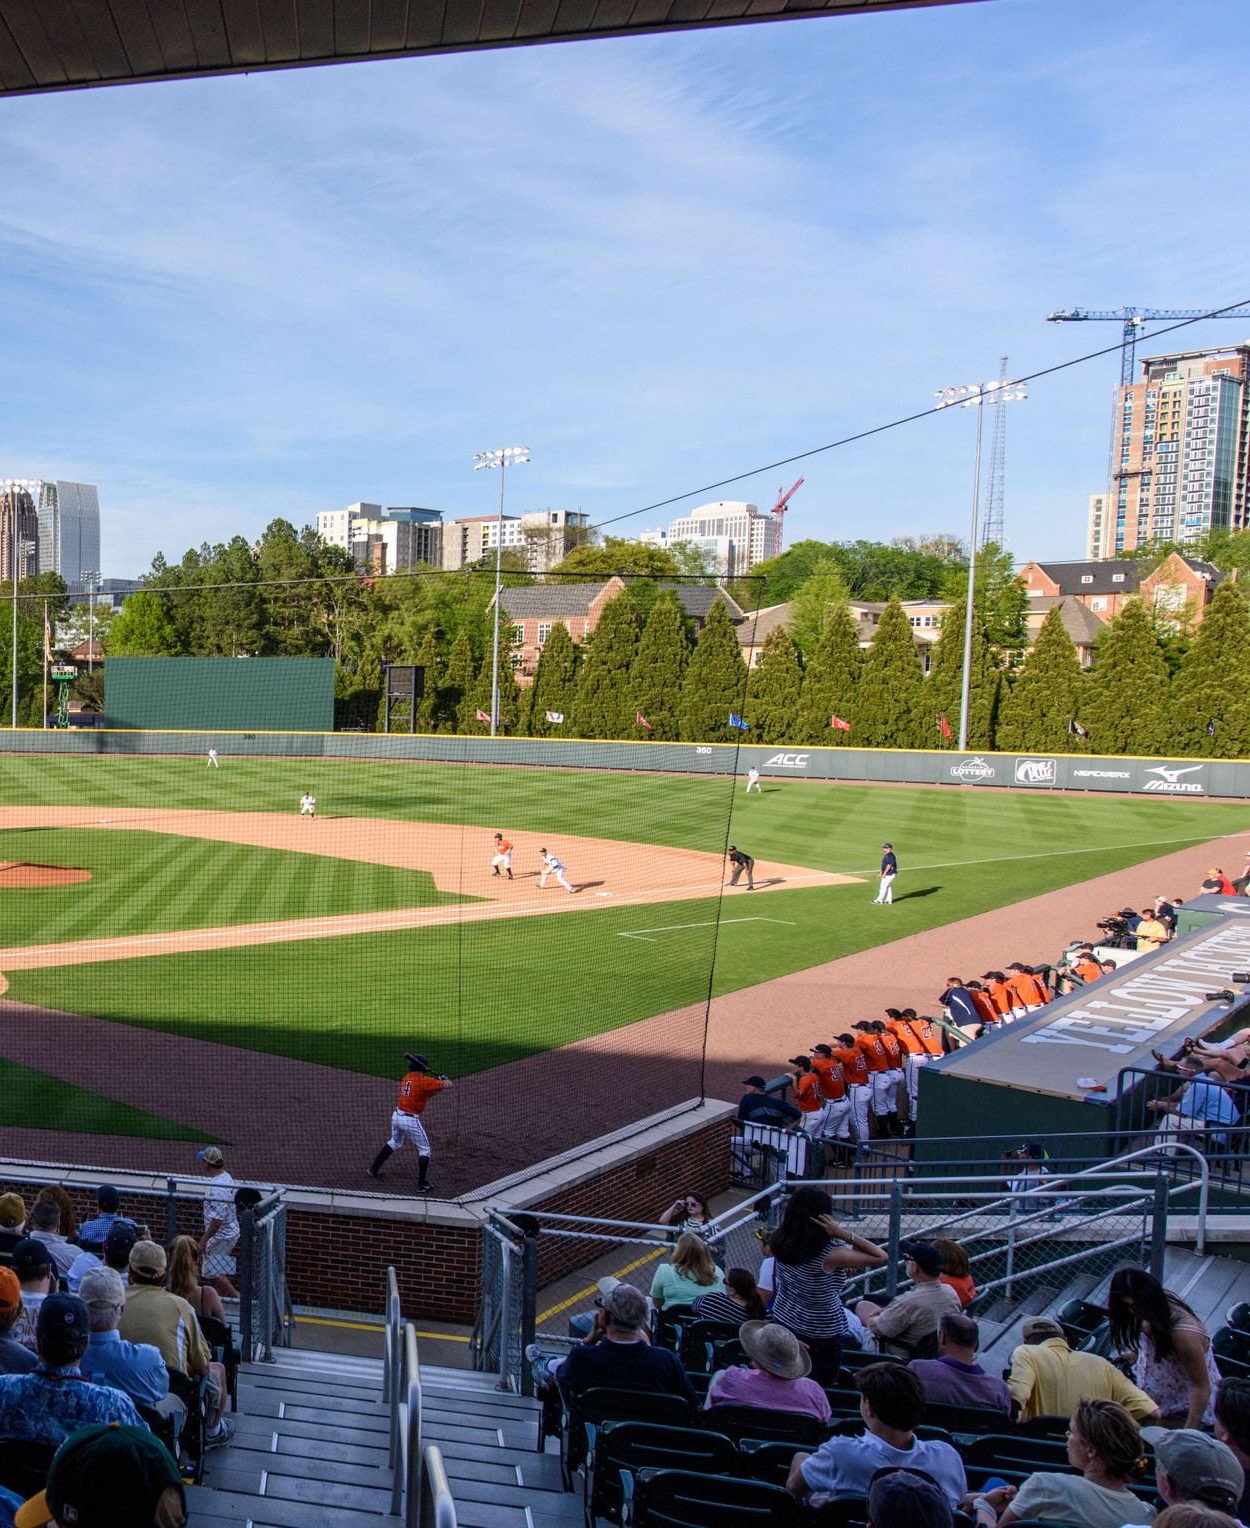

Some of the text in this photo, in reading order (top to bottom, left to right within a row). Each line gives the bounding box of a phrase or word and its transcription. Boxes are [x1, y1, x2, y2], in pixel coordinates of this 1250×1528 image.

[696, 746, 712, 754] 350
[765, 753, 810, 766] ACC
[953, 768, 993, 776] LOTTERY
[1074, 769, 1131, 779] NEADWERX
[1020, 972, 1226, 1055] YELLOW
[402, 1080, 413, 1097] 4
[324, 1310, 387, 1321] STANDIN
